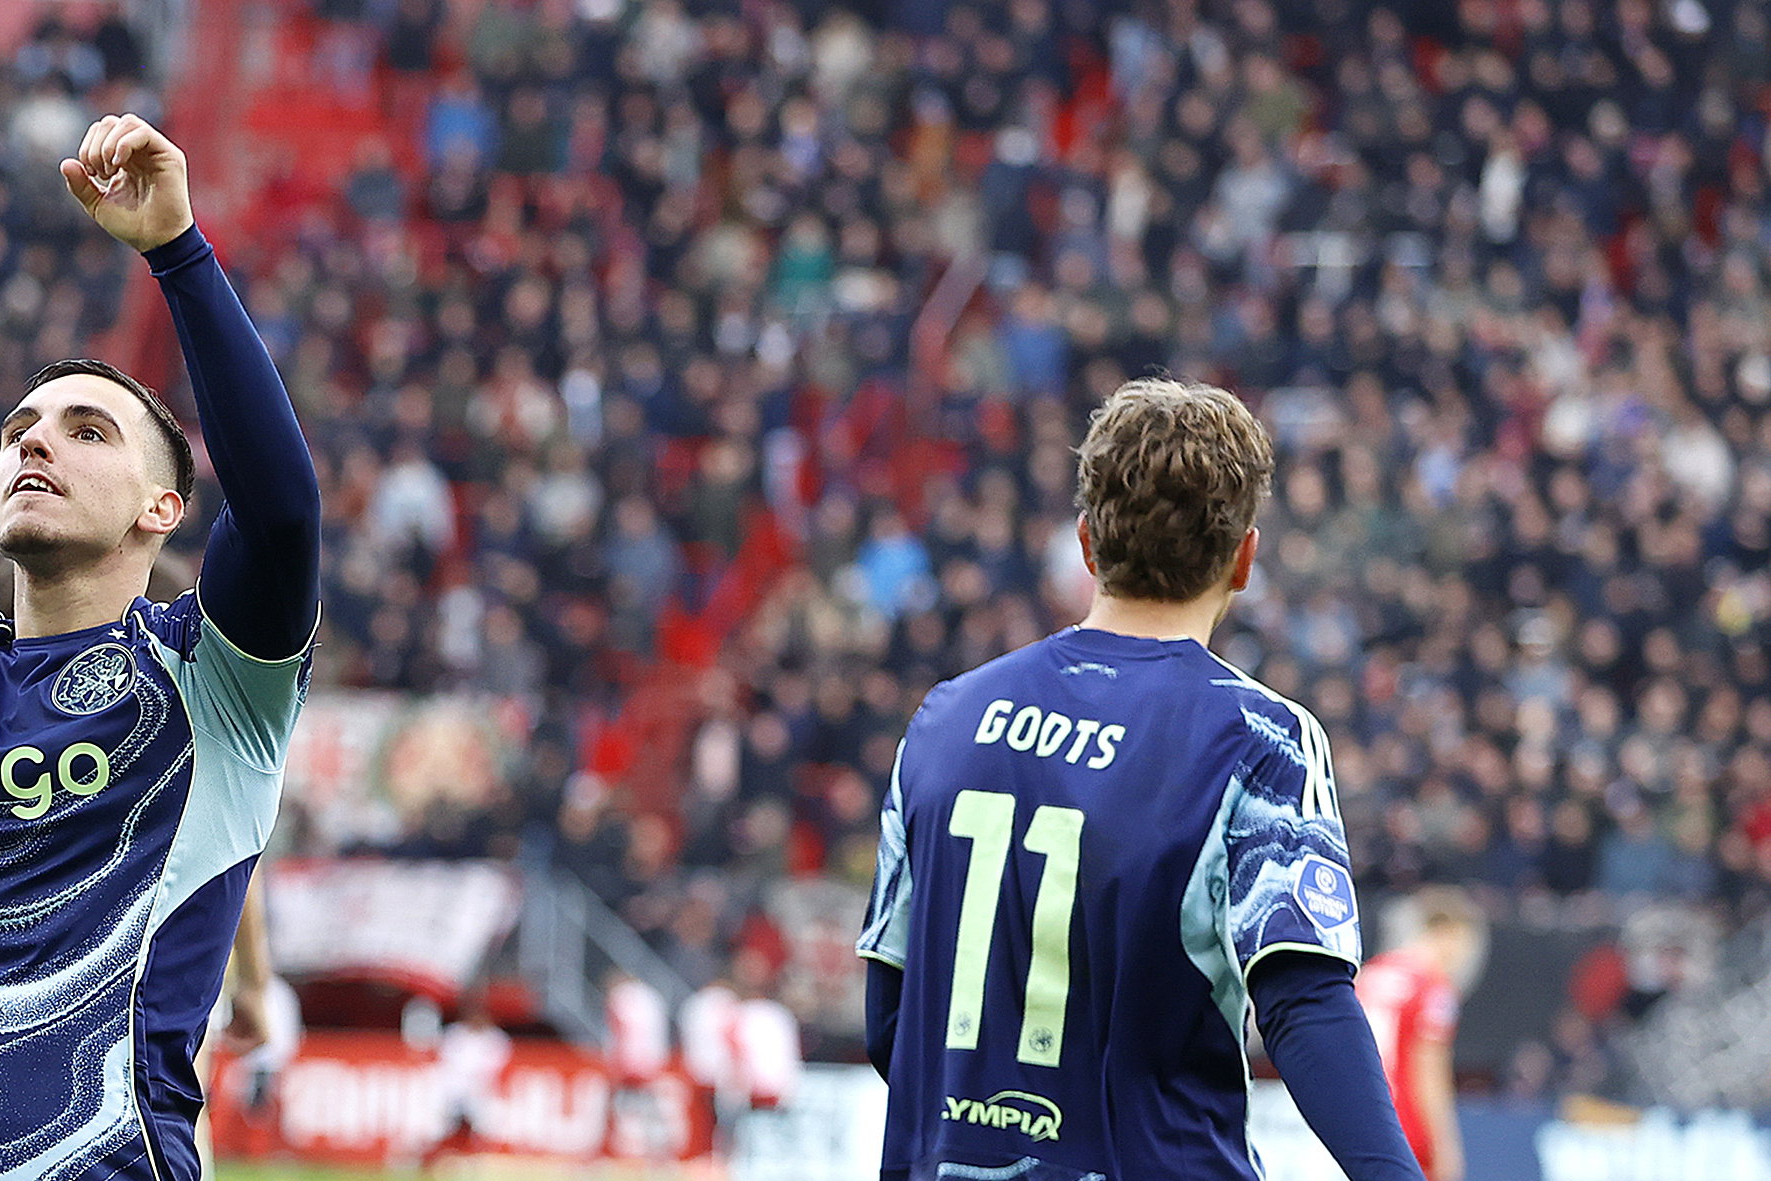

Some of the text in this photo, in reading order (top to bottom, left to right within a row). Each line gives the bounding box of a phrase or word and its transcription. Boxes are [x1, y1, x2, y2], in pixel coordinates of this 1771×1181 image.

[974, 699, 1127, 770] GODTS
[947, 789, 1085, 1068] 11
[941, 1090, 1062, 1142] YMPIA
